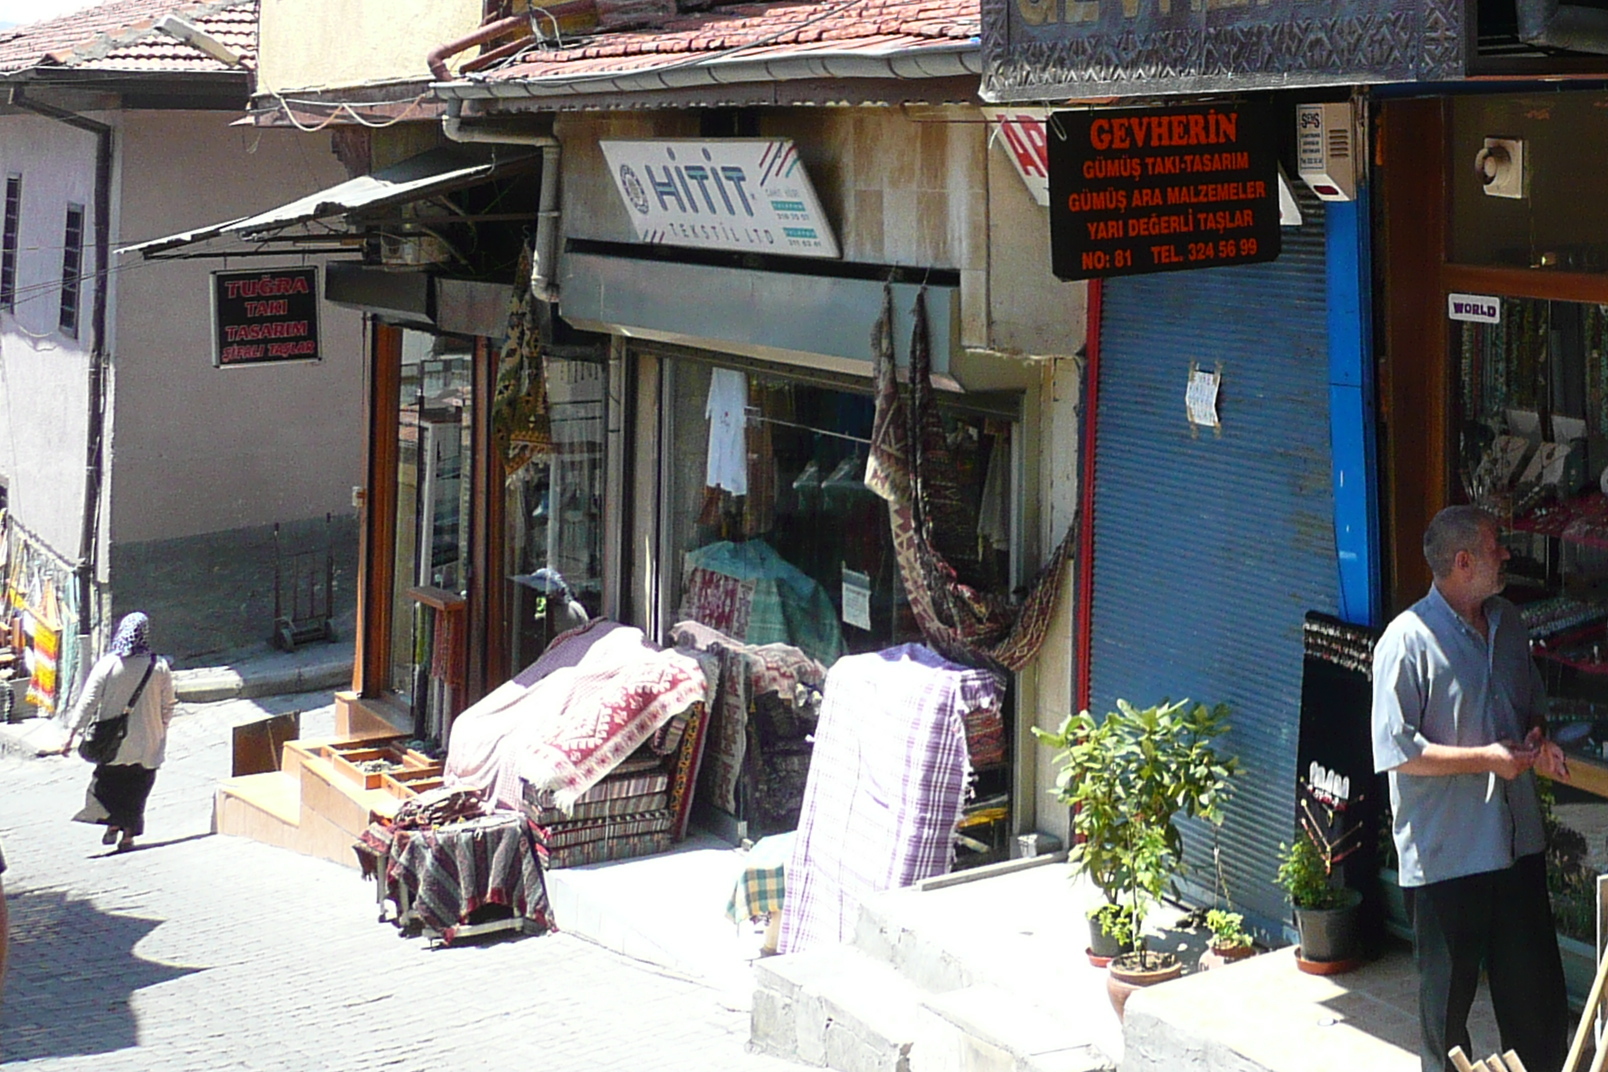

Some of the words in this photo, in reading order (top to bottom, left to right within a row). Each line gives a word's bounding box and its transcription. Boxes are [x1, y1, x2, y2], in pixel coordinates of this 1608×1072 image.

[1090, 109, 1238, 150] GEVHERİN
[1083, 154, 1141, 181] GÜMÜŞ
[1145, 152, 1248, 175] TAKI-TASARIM
[644, 147, 754, 217] HİTİT
[1068, 186, 1127, 212] GÜMÜŞ
[1131, 188, 1163, 208] ARA
[1168, 181, 1266, 205] MALZEMELER
[669, 222, 740, 242] TEKSTİL
[1087, 220, 1123, 240] YARI
[1128, 208, 1193, 237] DEĞERLİ
[1197, 209, 1253, 234] TAŞLAR
[1081, 251, 1110, 270] NO:
[1114, 249, 1132, 266] 81
[1151, 245, 1184, 264] TEL.
[1188, 242, 1214, 261] 324
[1218, 240, 1236, 258] 56
[1240, 238, 1258, 255] 99
[224, 274, 309, 299] TUĞRA
[244, 299, 288, 317] TAKI
[1453, 302, 1497, 317] WORLD
[225, 320, 308, 341] TASARIM
[222, 343, 265, 362] ŞİFALI
[267, 340, 315, 358] TAŞLAR
